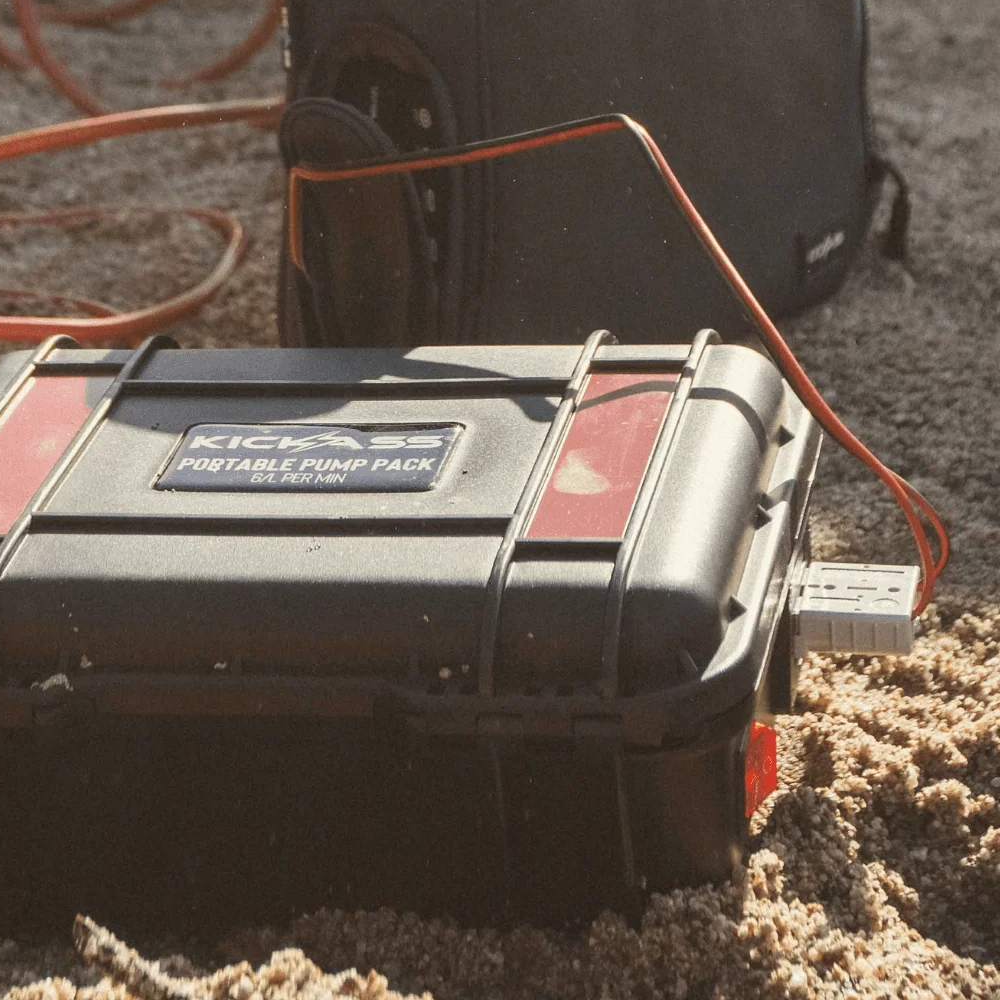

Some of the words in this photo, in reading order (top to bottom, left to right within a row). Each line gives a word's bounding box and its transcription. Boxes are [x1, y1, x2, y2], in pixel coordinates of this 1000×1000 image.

[189, 431, 444, 452] KICKASS
[177, 458, 296, 472] PORTABLE
[302, 458, 369, 472] PUMP
[372, 457, 436, 471] PACK
[250, 473, 276, 483] 6/L
[281, 473, 314, 483] PER
[315, 473, 347, 483] MIN
